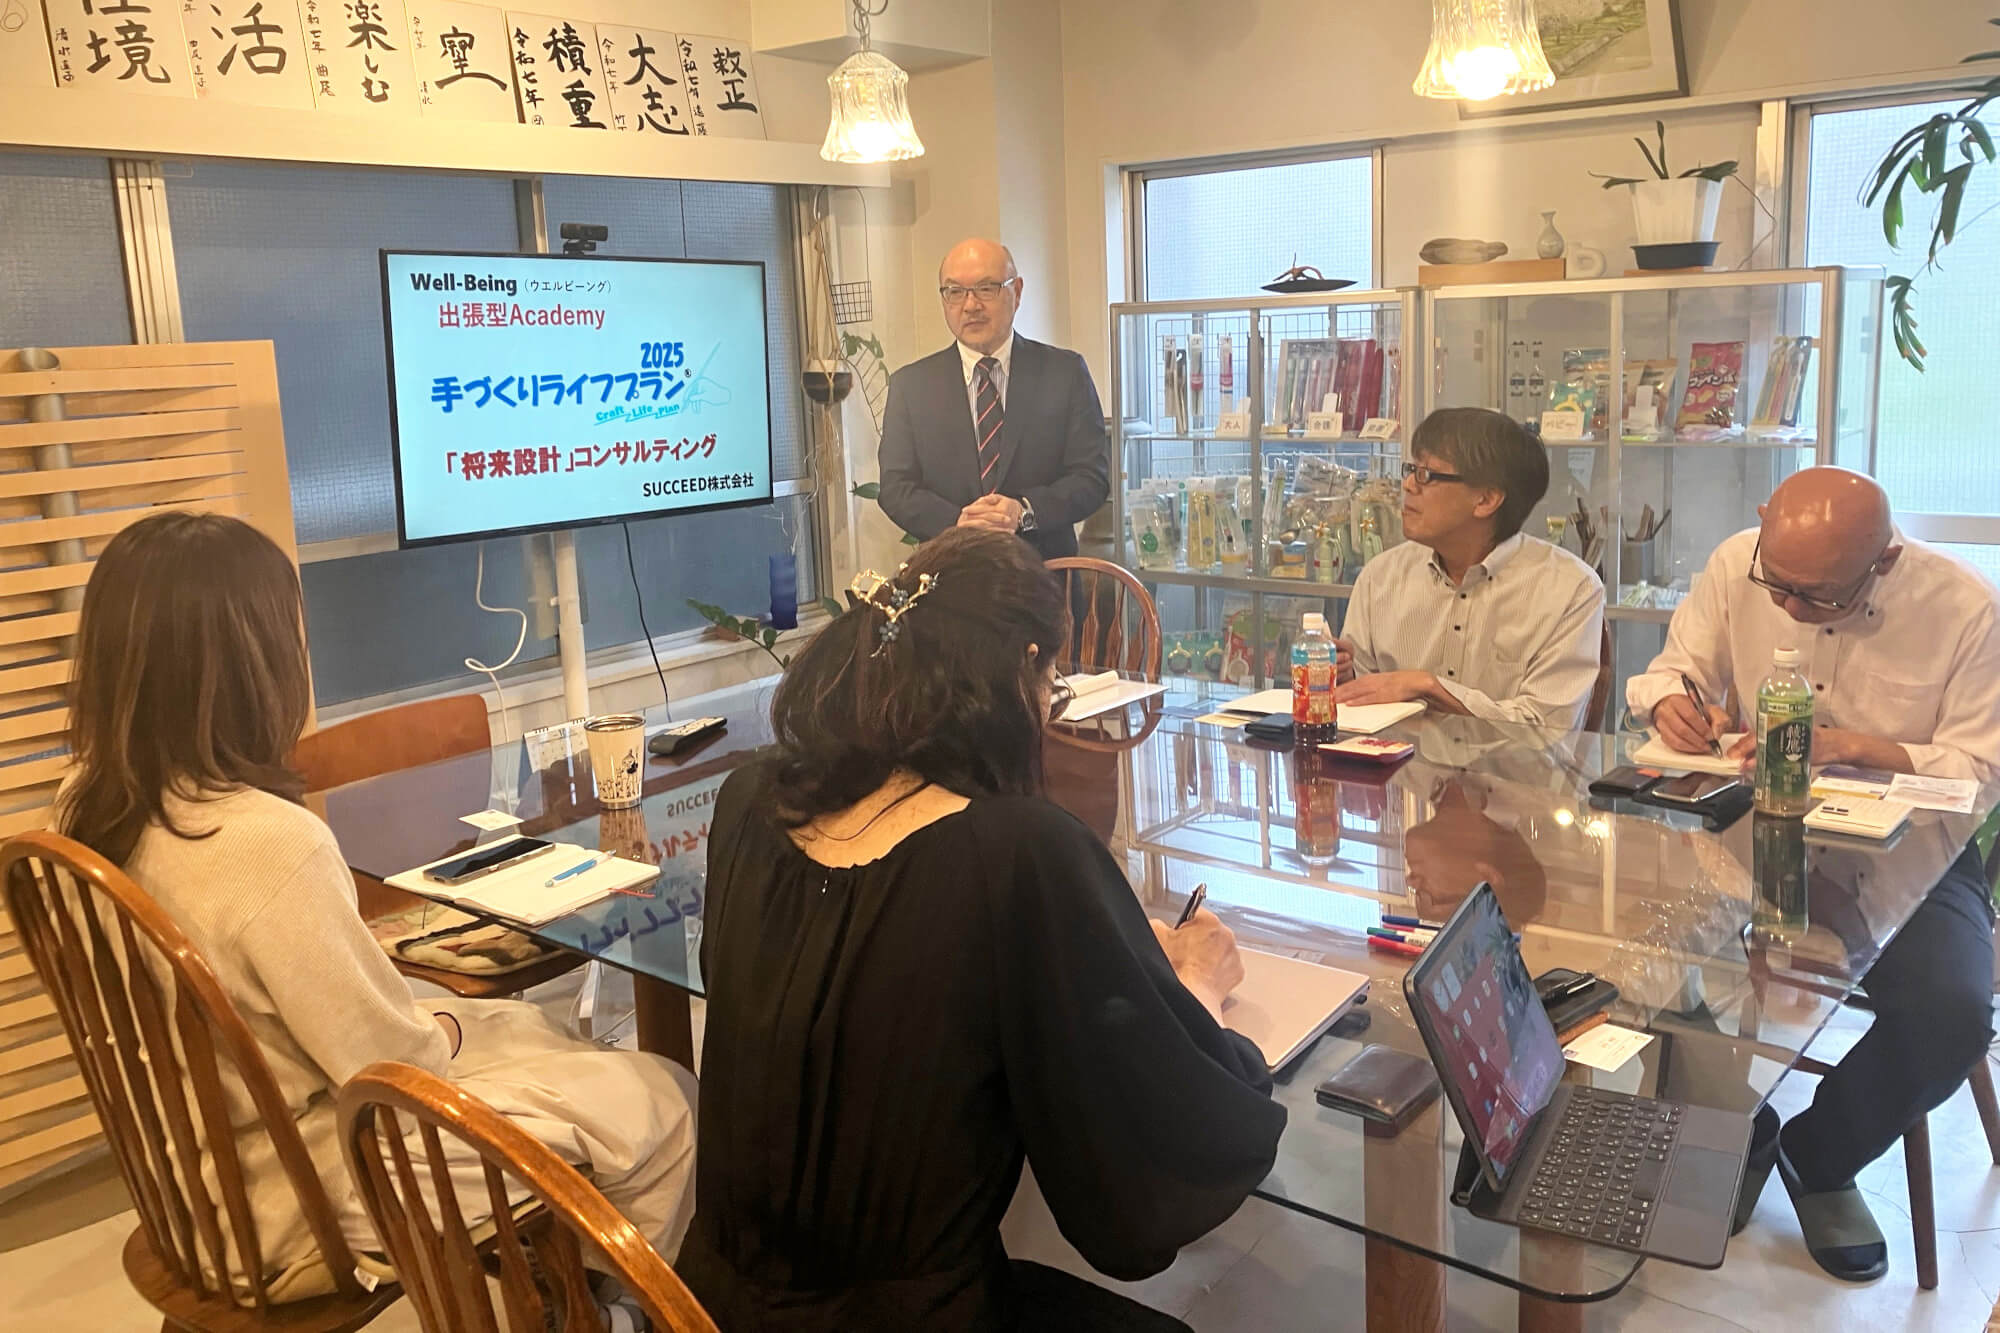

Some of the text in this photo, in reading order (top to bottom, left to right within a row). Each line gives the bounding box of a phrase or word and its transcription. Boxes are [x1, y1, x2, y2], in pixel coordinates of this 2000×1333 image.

[82, 0, 172, 84] 境
[209, 2, 287, 76] 活
[343, 0, 399, 103] 楽しむ
[513, 27, 545, 109] 令和七年
[601, 38, 619, 94] 令和七年
[623, 32, 690, 136] 大志
[410, 272, 518, 297] Well-Being
[439, 302, 606, 330] 出張型Academy
[640, 341, 684, 369] 2025
[431, 370, 685, 413] 手づくりライフプラン
[595, 403, 680, 422] Craft Life Plan
[642, 472, 755, 497] SUCCEED株式会社
